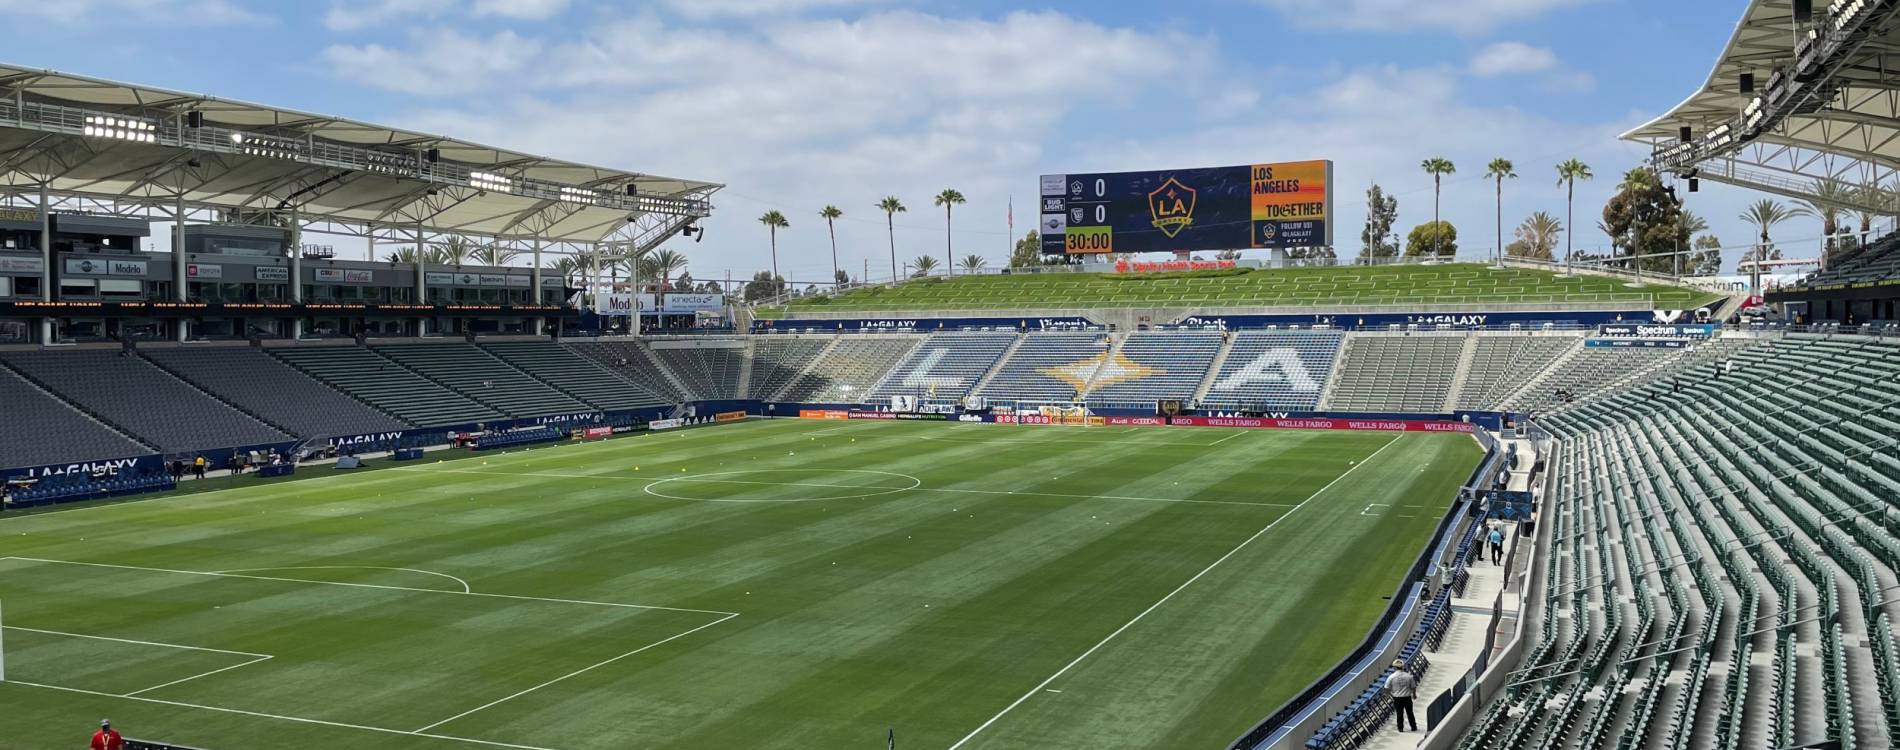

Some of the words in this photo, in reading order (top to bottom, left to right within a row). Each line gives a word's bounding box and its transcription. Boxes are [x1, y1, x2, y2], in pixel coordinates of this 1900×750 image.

[1254, 167, 1273, 180] LOS
[1095, 178, 1106, 197] 0
[1254, 180, 1299, 194] ANGELES
[1095, 204, 1106, 223] 0
[1159, 198, 1187, 216] LA
[1265, 202, 1323, 217] TOGETHER
[1068, 233, 1110, 250] 30:00
[115, 264, 141, 274] Modelo
[1434, 315, 1487, 326] GALAXY
[1636, 325, 1676, 336] Spectrum
[1424, 423, 1454, 431] WELLS
